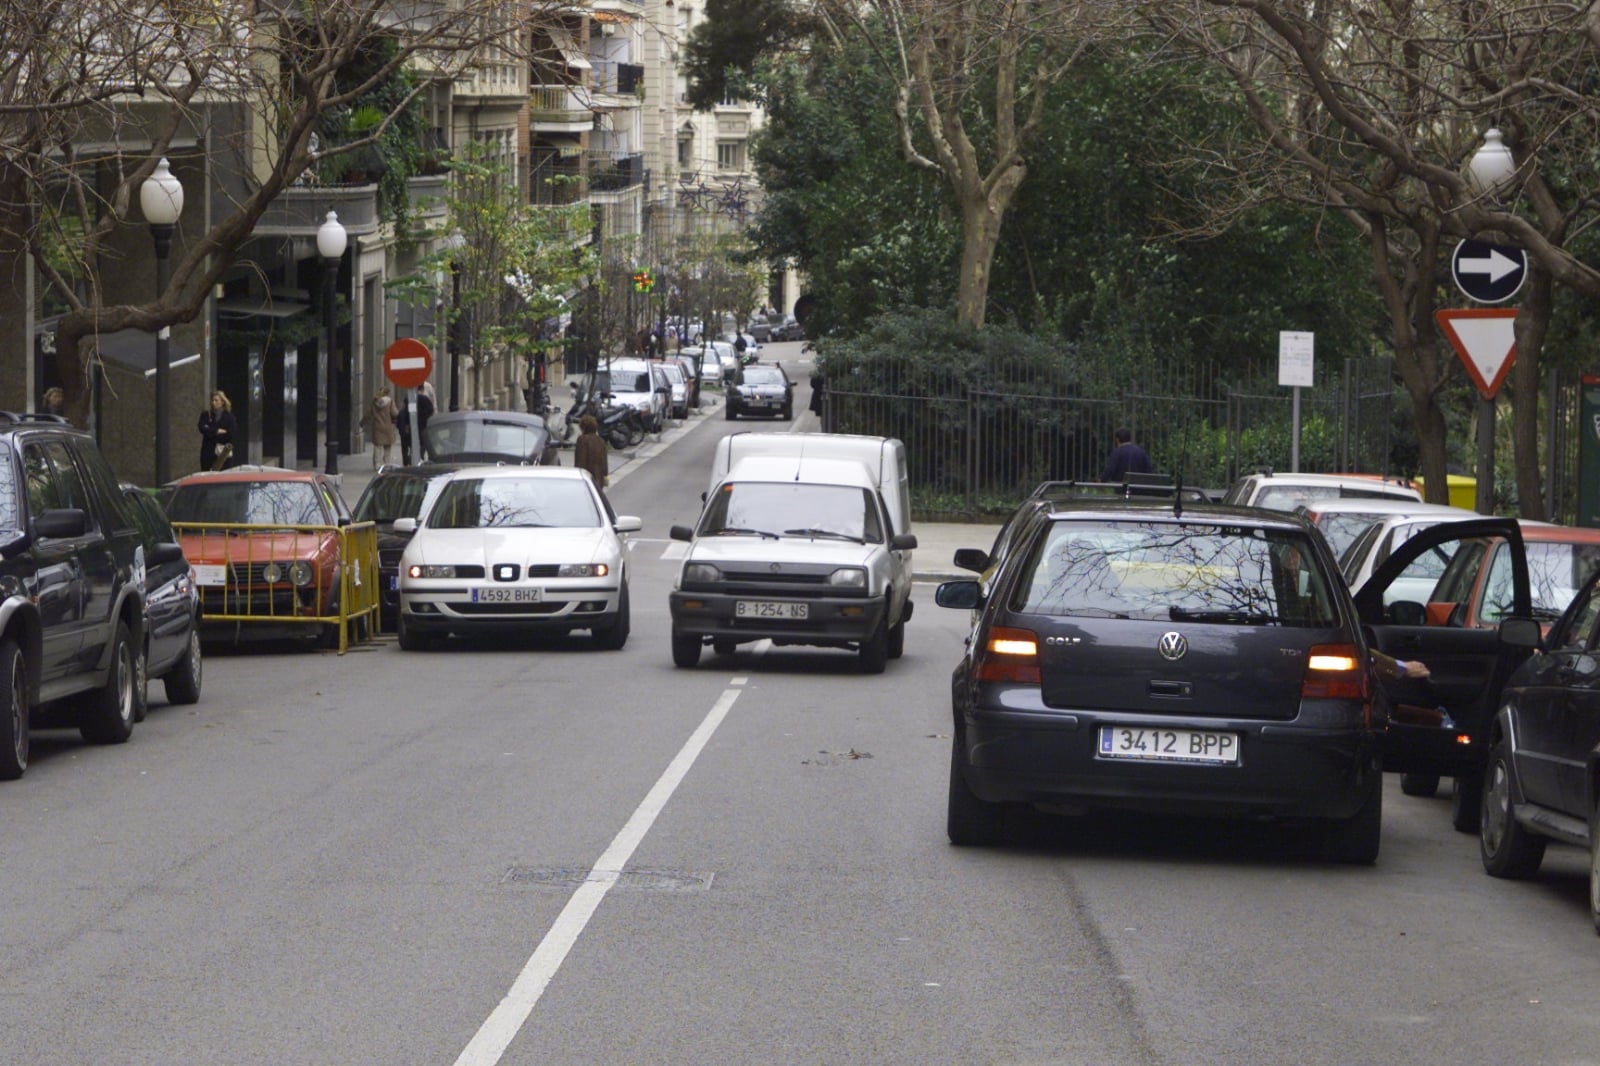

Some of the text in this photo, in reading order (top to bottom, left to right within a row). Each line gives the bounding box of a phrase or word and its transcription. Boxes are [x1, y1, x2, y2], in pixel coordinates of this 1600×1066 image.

[480, 589, 538, 601] 4592 BHZ
[1046, 636, 1081, 646] GOLF
[1120, 729, 1177, 753] 3412
[1189, 733, 1232, 756] BPP
